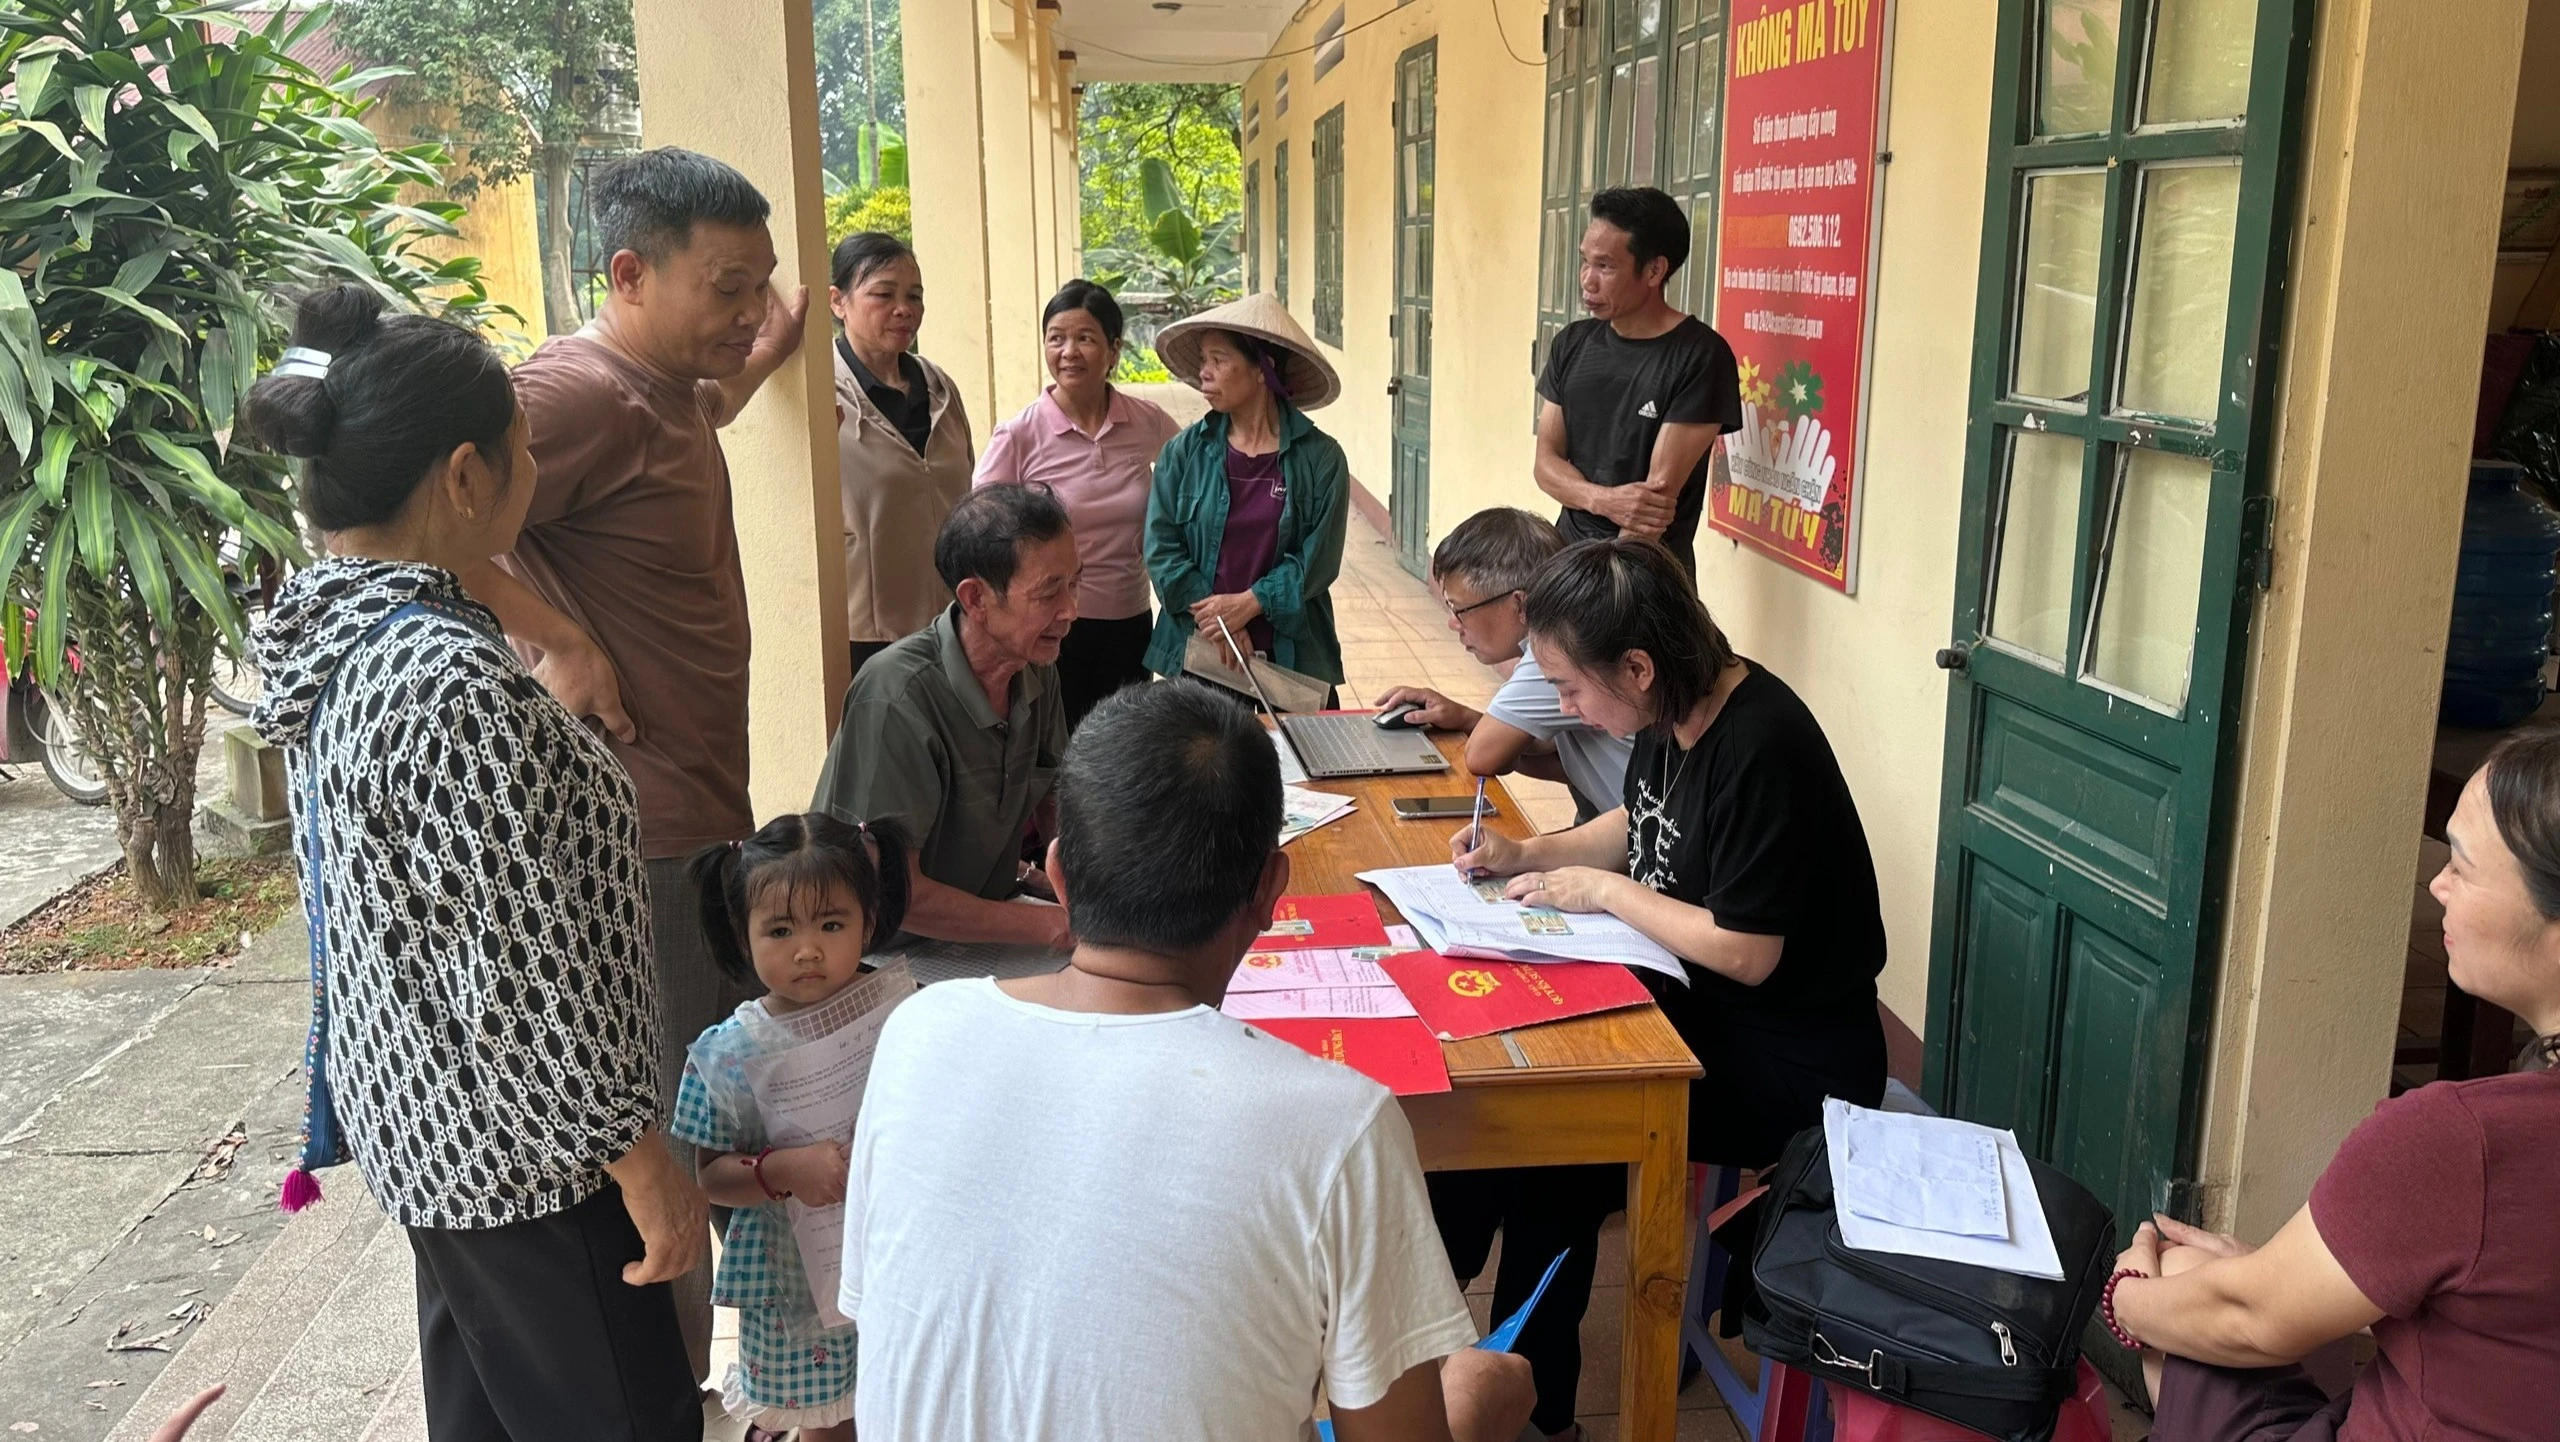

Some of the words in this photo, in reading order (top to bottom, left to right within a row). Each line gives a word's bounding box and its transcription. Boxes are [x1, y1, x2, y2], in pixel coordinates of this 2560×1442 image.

[1735, 5, 1792, 78] KHÔNG
[1796, 0, 1826, 63] MA
[1728, 484, 1763, 526] MA
